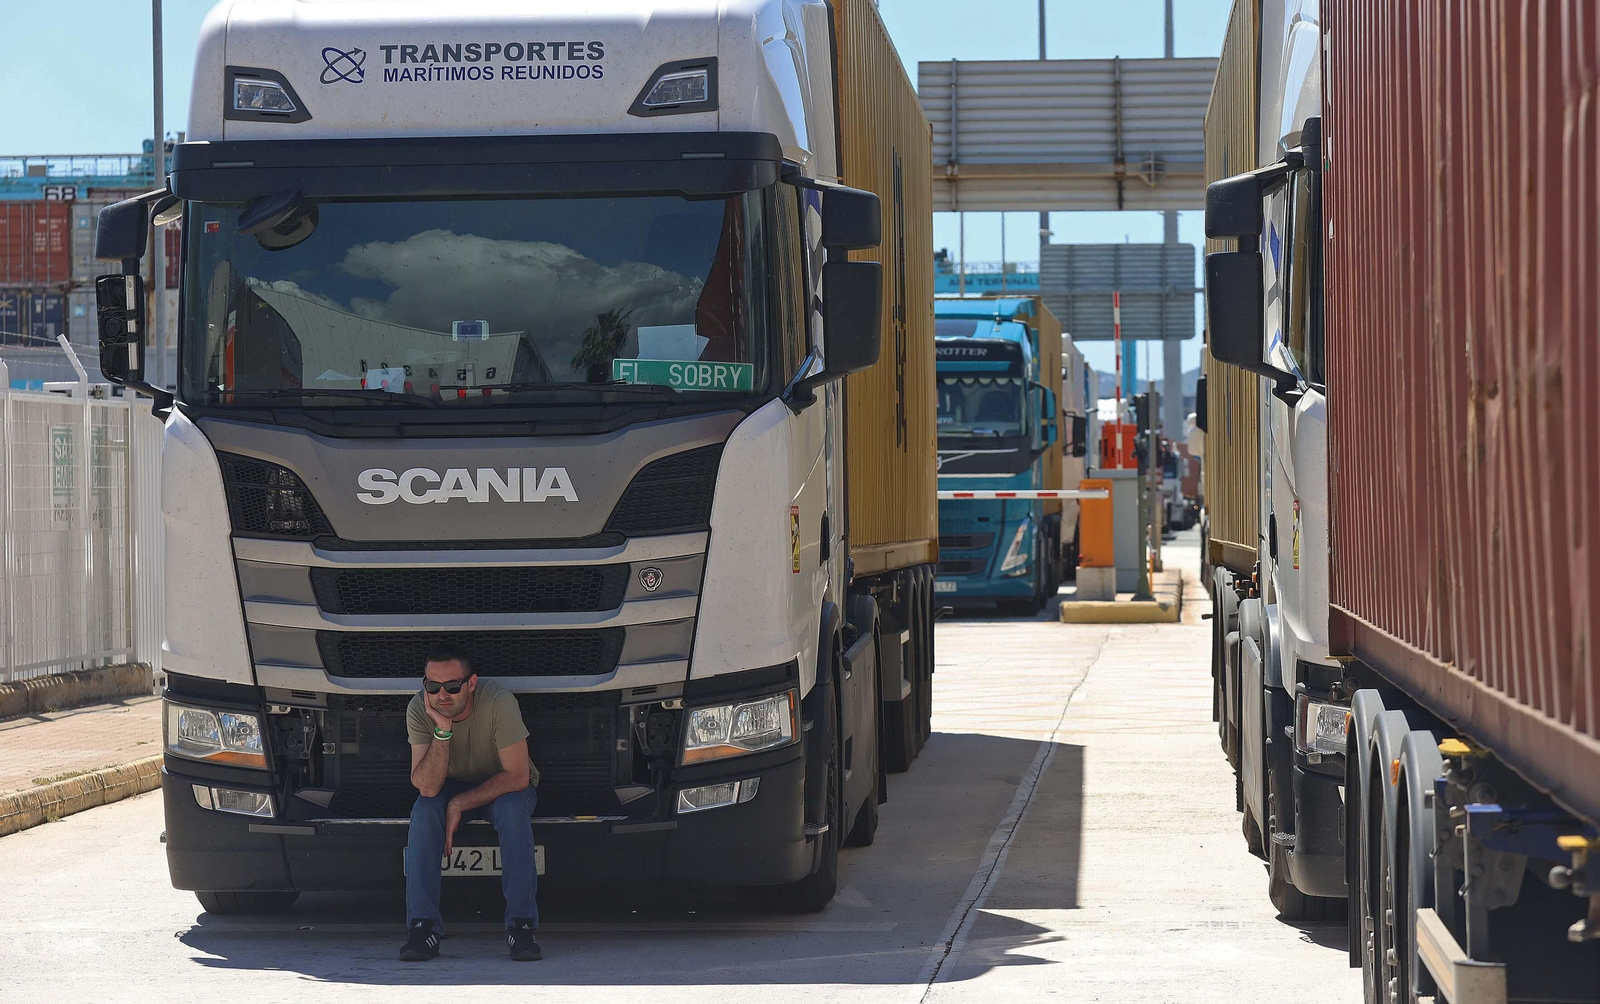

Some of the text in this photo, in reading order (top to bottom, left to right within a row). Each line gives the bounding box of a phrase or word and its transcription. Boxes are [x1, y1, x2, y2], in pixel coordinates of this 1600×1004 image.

[379, 41, 605, 64] TRANSPORTES
[383, 63, 604, 82] MARÍTIMOS REUNIDOS
[619, 362, 743, 389] EL SOBRY
[356, 467, 579, 505] SCANIA
